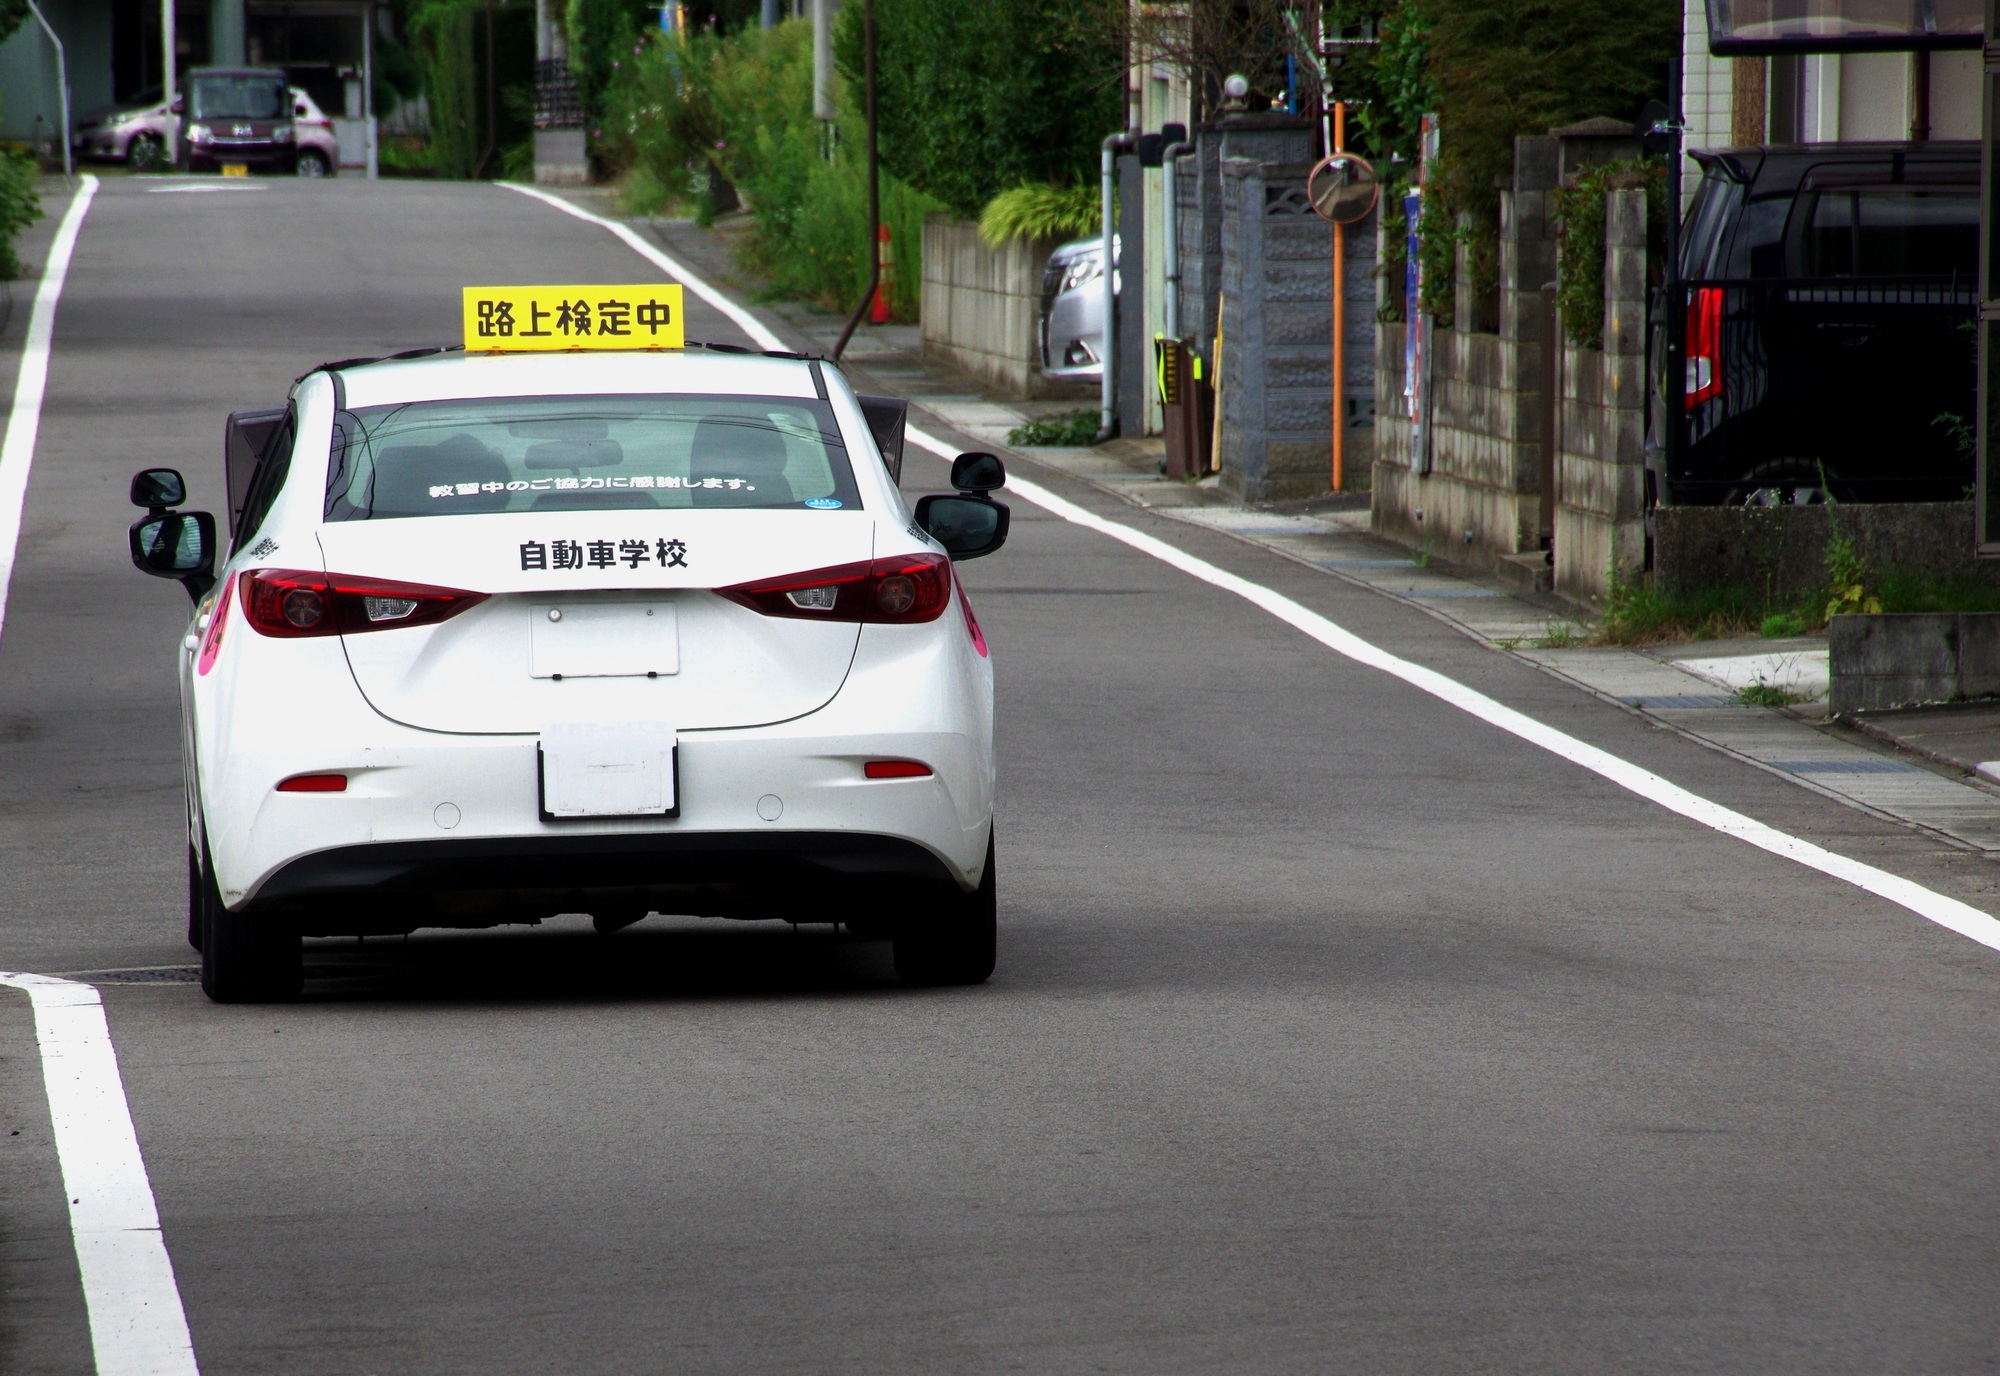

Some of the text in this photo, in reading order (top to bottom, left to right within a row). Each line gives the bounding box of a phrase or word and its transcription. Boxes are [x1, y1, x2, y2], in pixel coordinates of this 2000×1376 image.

[477, 299, 670, 337] 路上検定中
[428, 475, 756, 498] 教習中のご協力に感謝します。
[519, 537, 688, 571] 自動車学校
